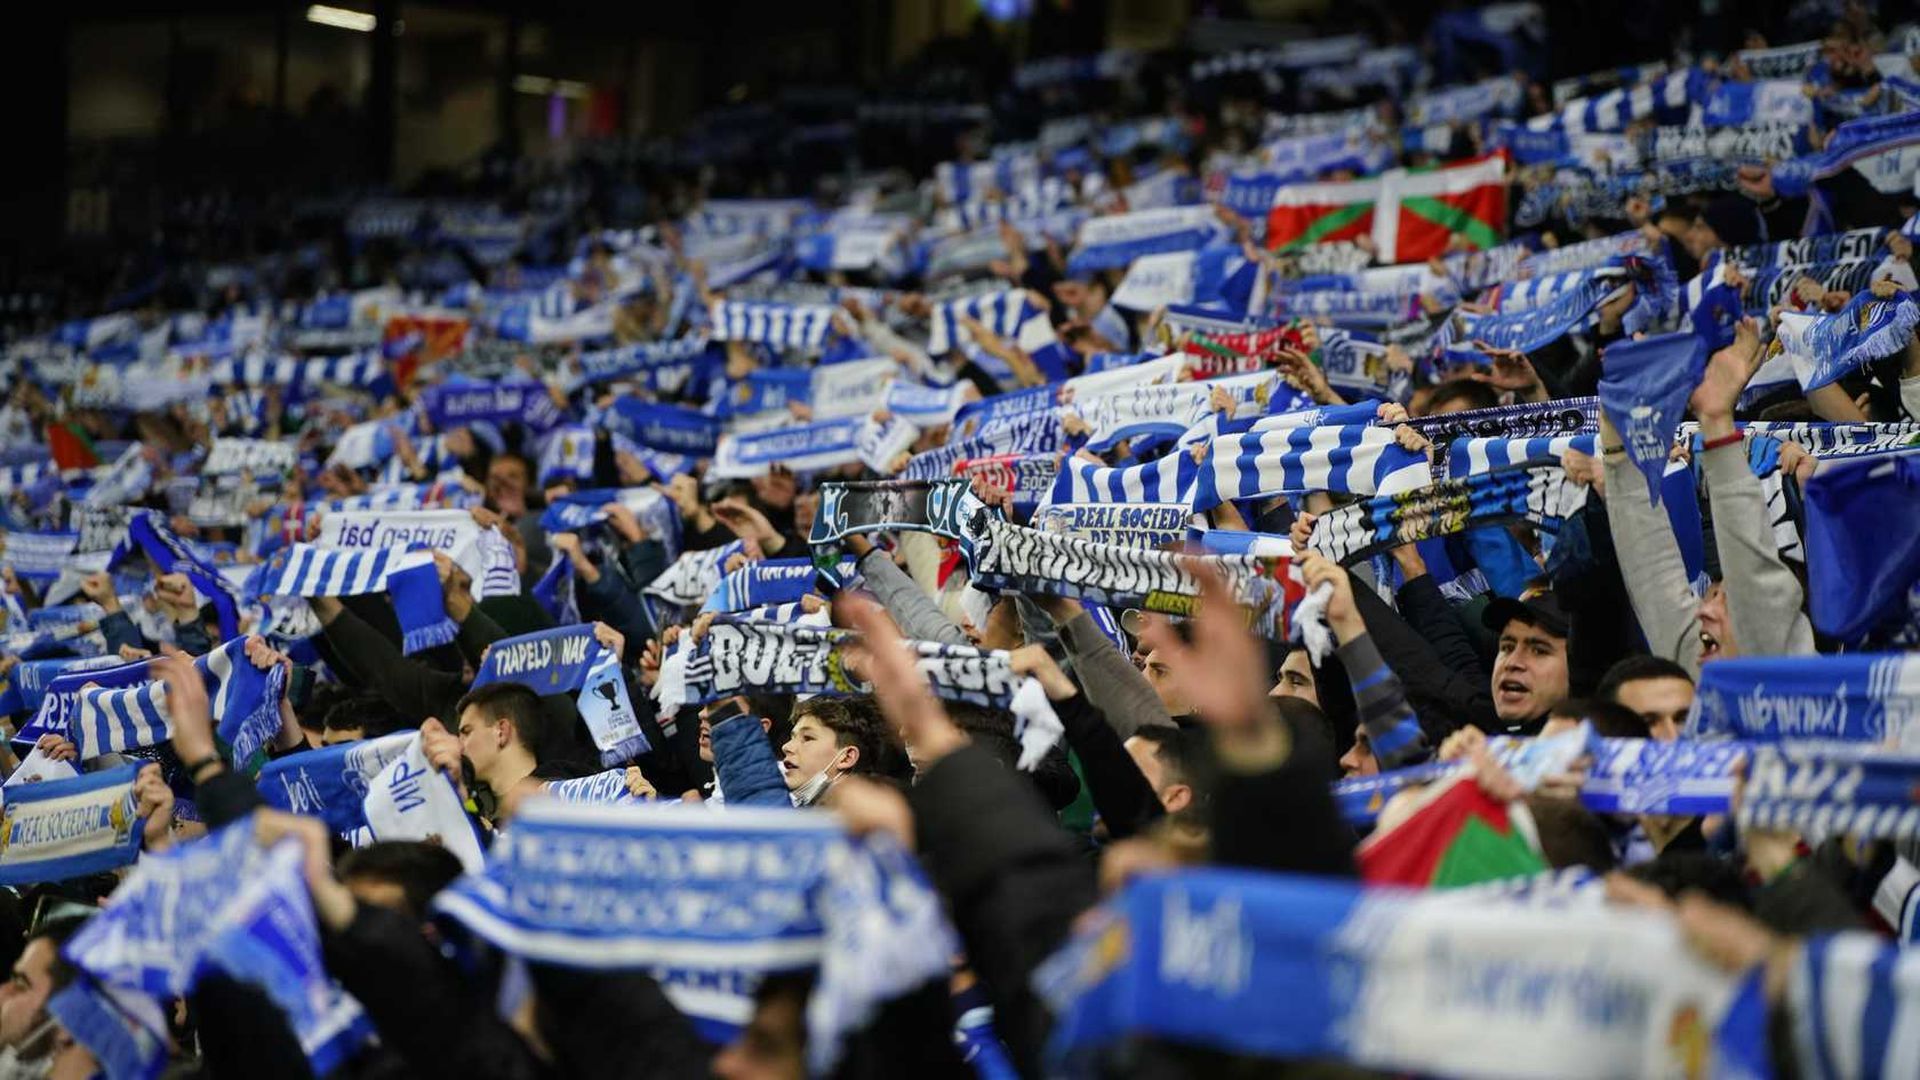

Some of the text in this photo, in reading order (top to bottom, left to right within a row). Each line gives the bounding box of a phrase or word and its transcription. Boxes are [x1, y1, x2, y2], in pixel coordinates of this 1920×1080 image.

[1074, 506, 1116, 529] REAL
[18, 804, 101, 847] REAL SOCIEDAD
